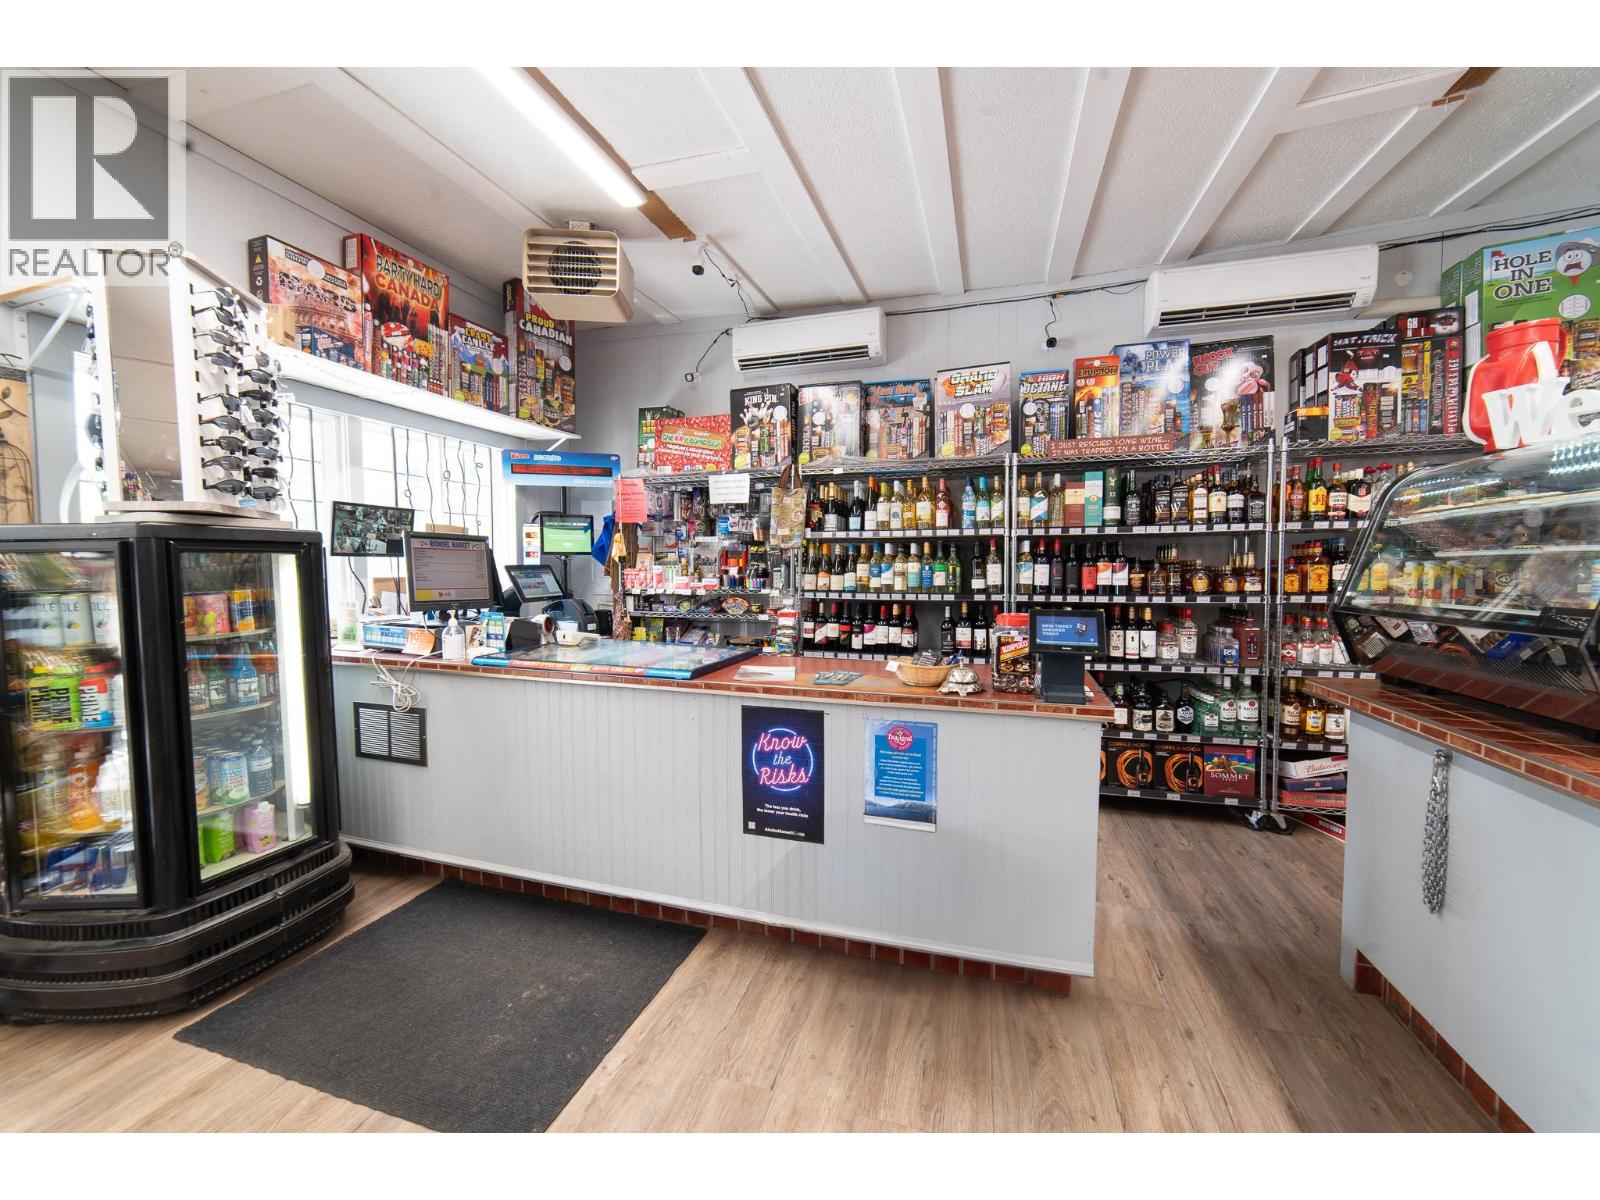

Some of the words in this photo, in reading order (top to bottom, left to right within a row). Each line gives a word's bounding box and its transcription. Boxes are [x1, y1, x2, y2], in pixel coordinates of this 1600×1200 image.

[1493, 250, 1552, 271] HOLE
[376, 253, 412, 282] PARTY
[412, 271, 442, 300] HARD
[1510, 266, 1535, 282] IN
[374, 271, 440, 312] CANADA
[1493, 277, 1552, 300] ONE
[525, 312, 555, 328] PROUD
[464, 327, 493, 342] CRAZY
[519, 319, 573, 346] CANADIAN
[1333, 337, 1357, 346] HAT
[1361, 333, 1399, 344] TRICK
[462, 335, 496, 352] CANUCK
[1192, 347, 1233, 365] KNOCK
[1078, 366, 1118, 377] ERUPTION
[1192, 362, 1219, 376] OUT
[950, 370, 1000, 385] GRAND
[1038, 373, 1066, 382] HIGH
[954, 384, 993, 398] SLAM
[1022, 381, 1067, 394] OCTANE
[744, 394, 763, 406] KING
[763, 393, 778, 403] PIN
[1058, 441, 1077, 449] JUST
[1079, 439, 1112, 448] RESCUED
[1114, 438, 1137, 446] SOME
[1080, 446, 1115, 454] TRAPPED
[1116, 445, 1128, 453] IN
[1139, 443, 1170, 451] BOTTLE
[757, 732, 807, 751] Know
[773, 751, 792, 765] the
[759, 764, 810, 785] Risks
[1210, 771, 1249, 780] SOMMET
